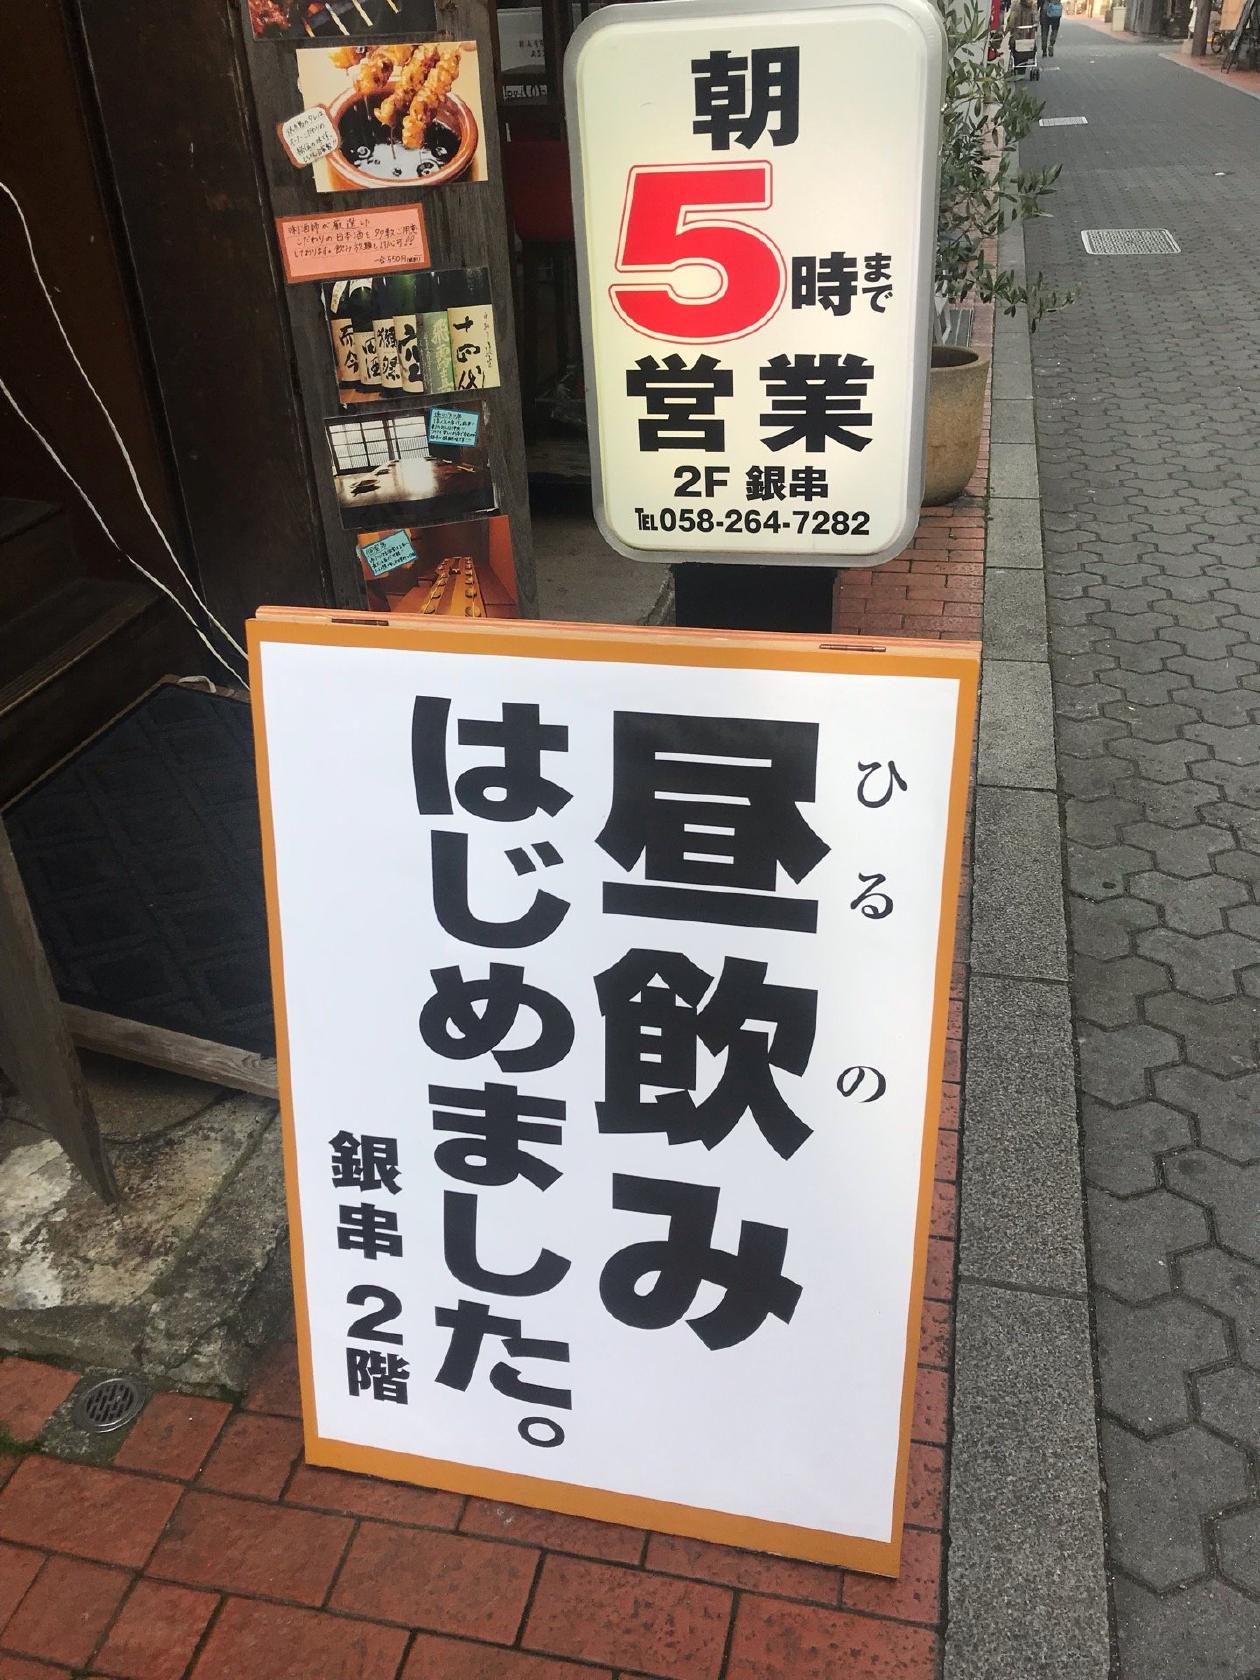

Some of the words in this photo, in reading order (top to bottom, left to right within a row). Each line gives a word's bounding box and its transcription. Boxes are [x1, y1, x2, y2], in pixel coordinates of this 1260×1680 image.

[692, 46, 799, 150] 朝
[453, 315, 486, 390] 十四代
[626, 354, 874, 452] 営業
[674, 466, 730, 497] 2F
[746, 466, 829, 501] 銀串
[411, 696, 575, 1447] はじめました。
[594, 711, 831, 1350] 昼飲み
[329, 1131, 403, 1260] 銀串
[346, 1284, 409, 1405] 2階
